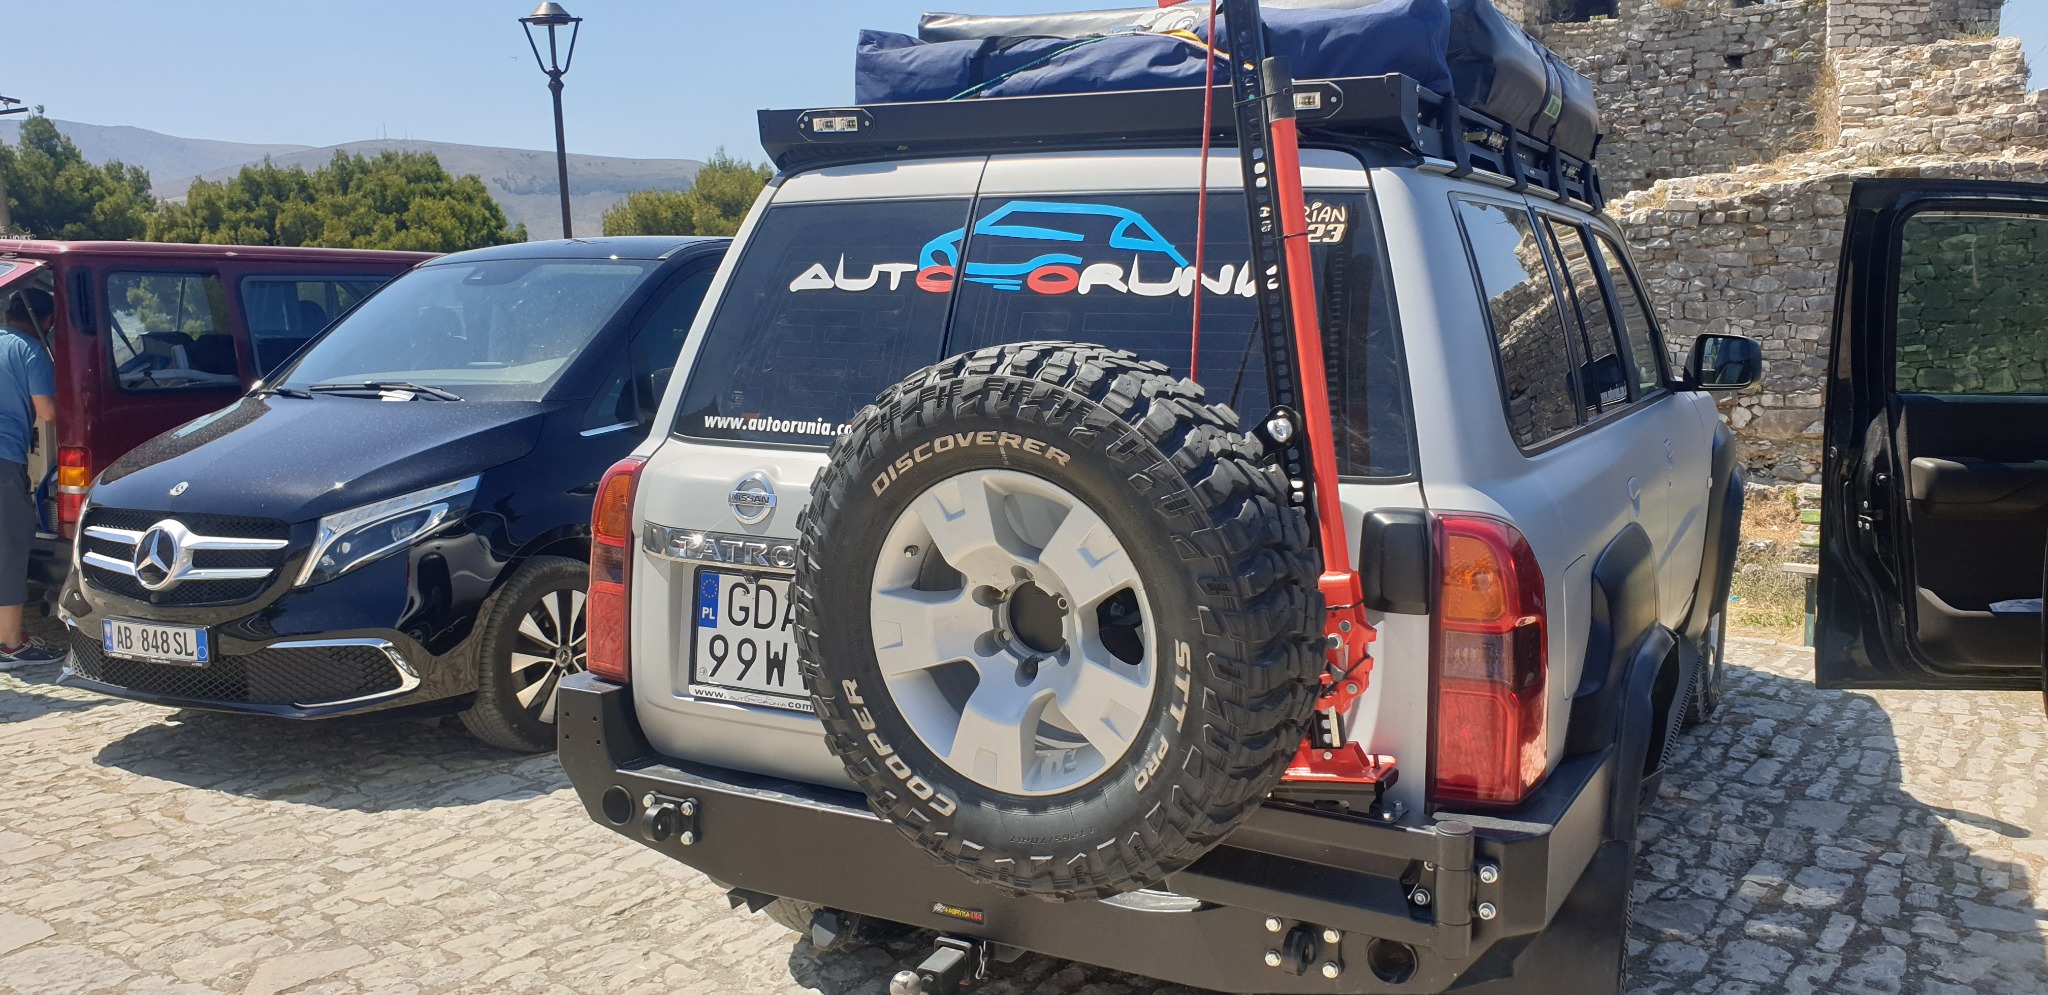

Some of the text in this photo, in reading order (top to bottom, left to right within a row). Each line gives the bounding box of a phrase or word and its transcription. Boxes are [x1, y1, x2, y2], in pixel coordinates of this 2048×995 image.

[1307, 223, 1345, 243] 23
[871, 430, 1071, 497] DISCOVERER
[731, 493, 770, 504] NISSAN
[702, 606, 716, 620] PL
[117, 625, 195, 657] AB 848 SL
[709, 634, 809, 691] 99W
[1135, 638, 1191, 792] STT PRO
[841, 678, 957, 817] COOPER
